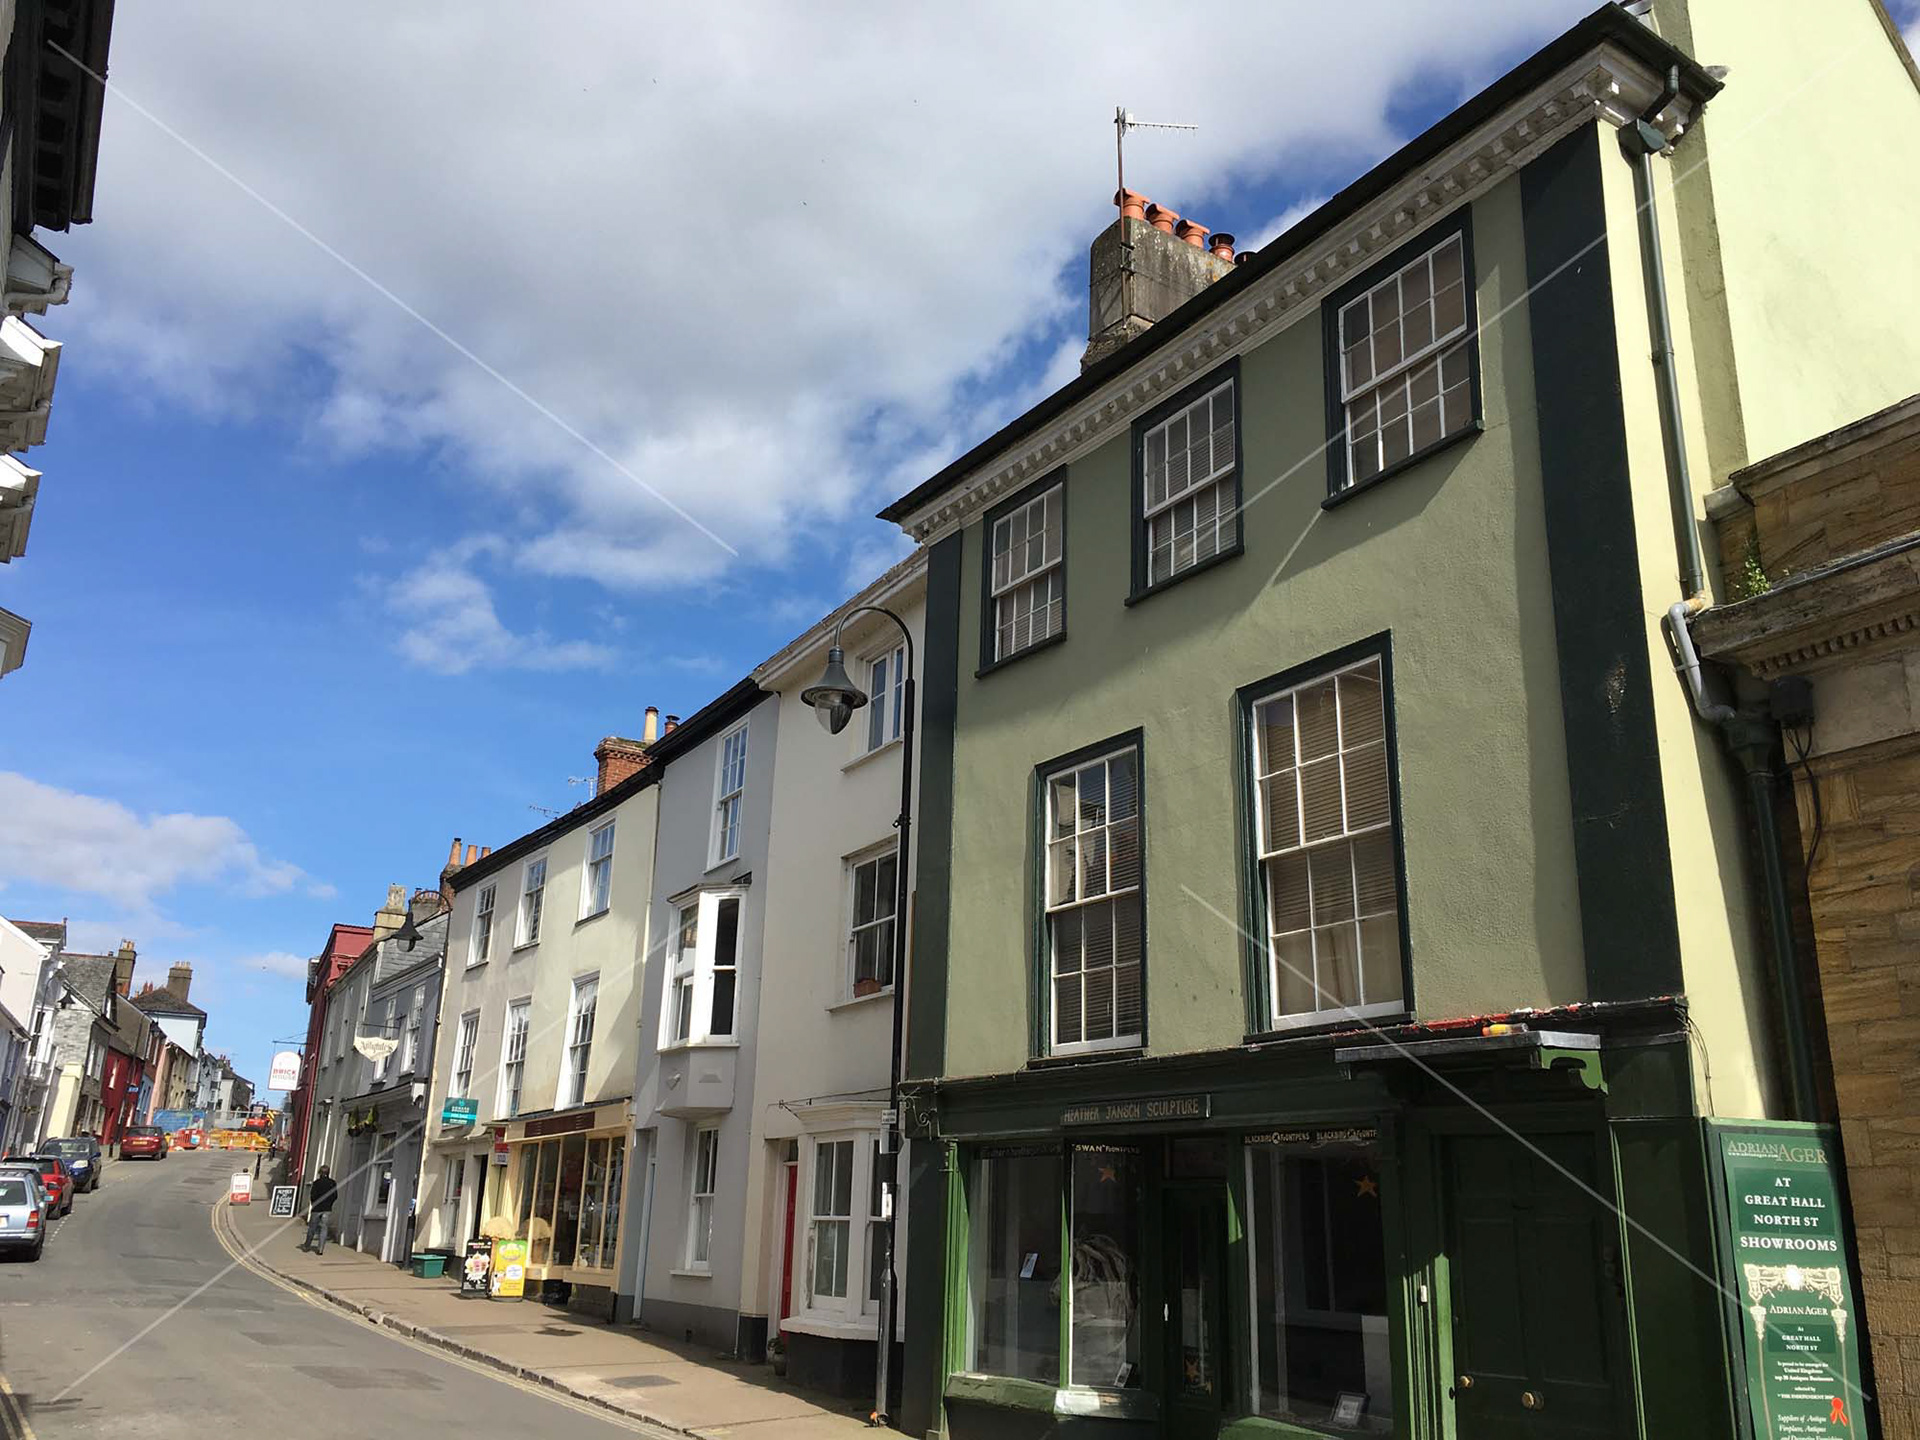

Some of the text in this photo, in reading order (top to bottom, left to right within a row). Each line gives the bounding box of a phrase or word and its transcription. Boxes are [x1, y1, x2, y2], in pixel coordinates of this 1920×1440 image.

[1064, 1098, 1199, 1122] HEATHER JANSCH SCULPTURE
[1728, 1141, 1828, 1164] ADRIAN AGER
[1775, 1177, 1791, 1187] AT
[1745, 1195, 1825, 1208] GREAT HALL
[1754, 1214, 1819, 1227] NORTH ST
[1741, 1236, 1837, 1252] SHOWROOMS
[1769, 1304, 1829, 1316] ADRIAN AGER
